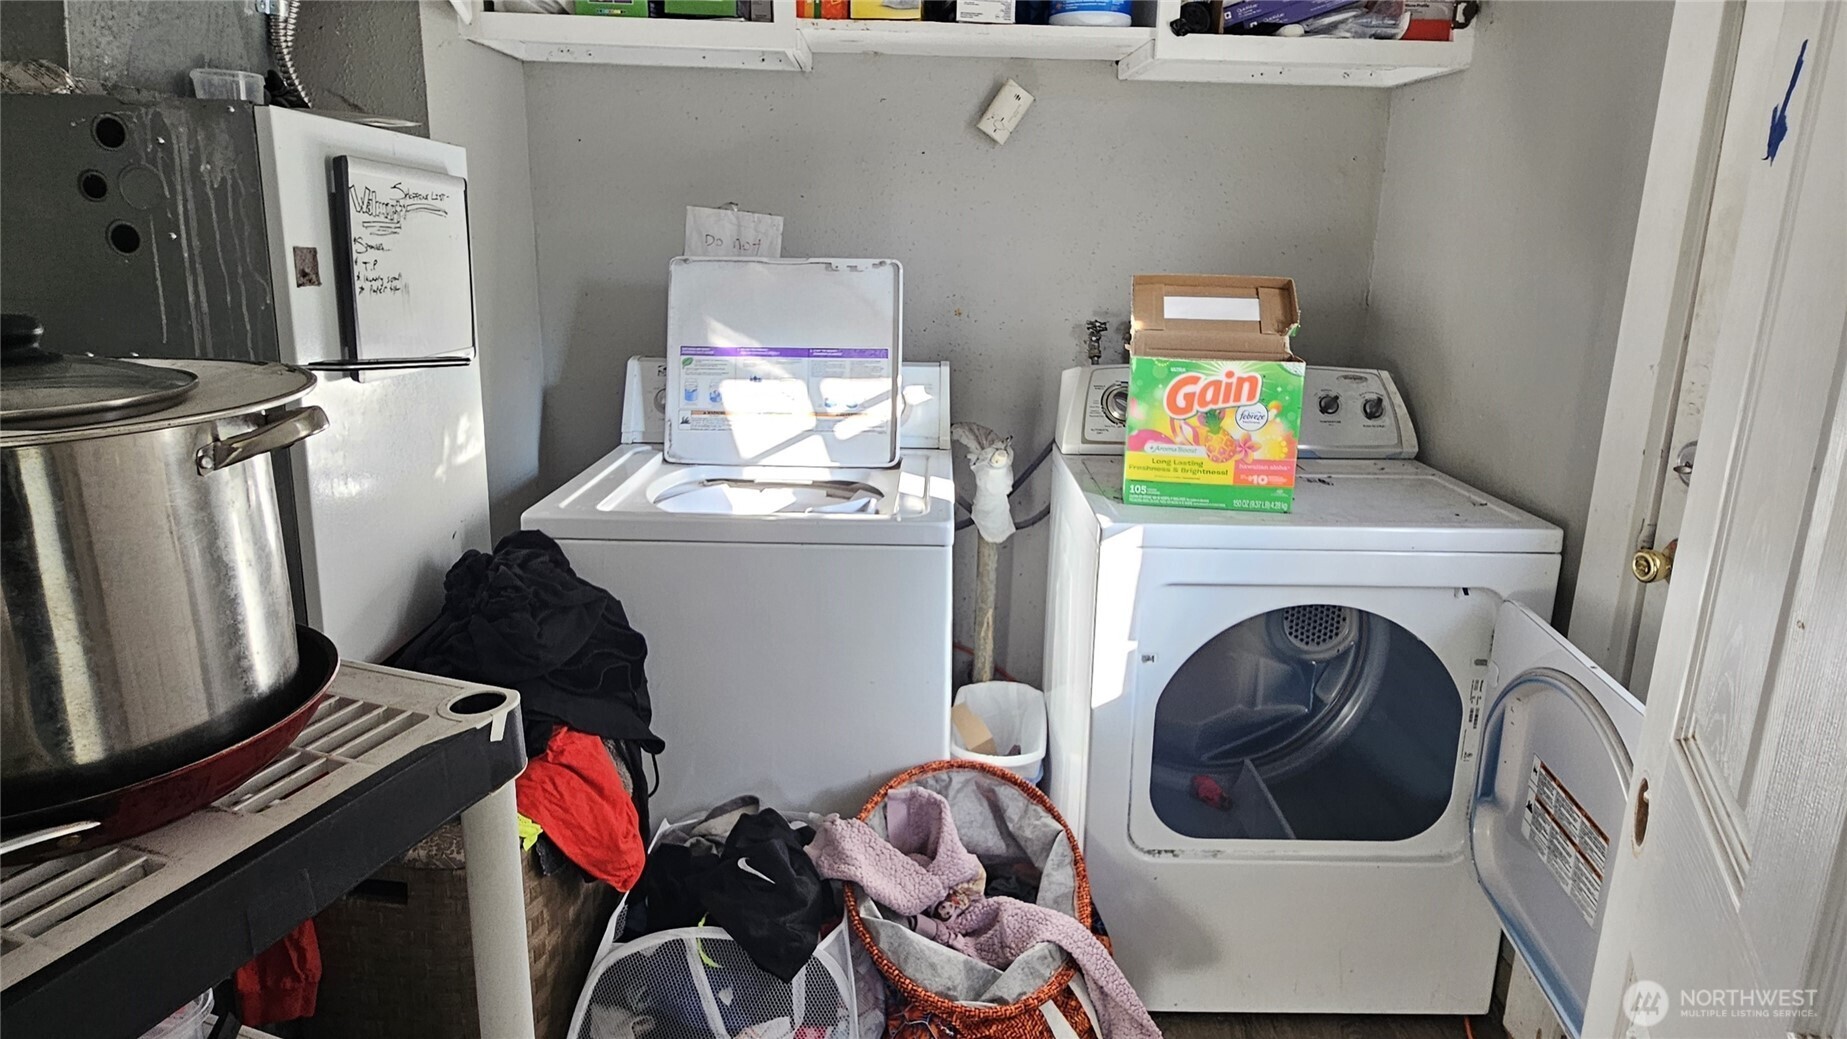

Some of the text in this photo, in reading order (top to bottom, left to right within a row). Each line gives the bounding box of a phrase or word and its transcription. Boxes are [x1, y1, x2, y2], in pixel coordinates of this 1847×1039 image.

[705, 234, 723, 247] Do
[1165, 370, 1260, 417] Gain
[1239, 409, 1266, 421] febreze
[1151, 457, 1204, 468] Long Lasting
[1128, 464, 1171, 473] Freshness
[1180, 466, 1229, 476] Brightness!
[1129, 484, 1147, 494] 105
